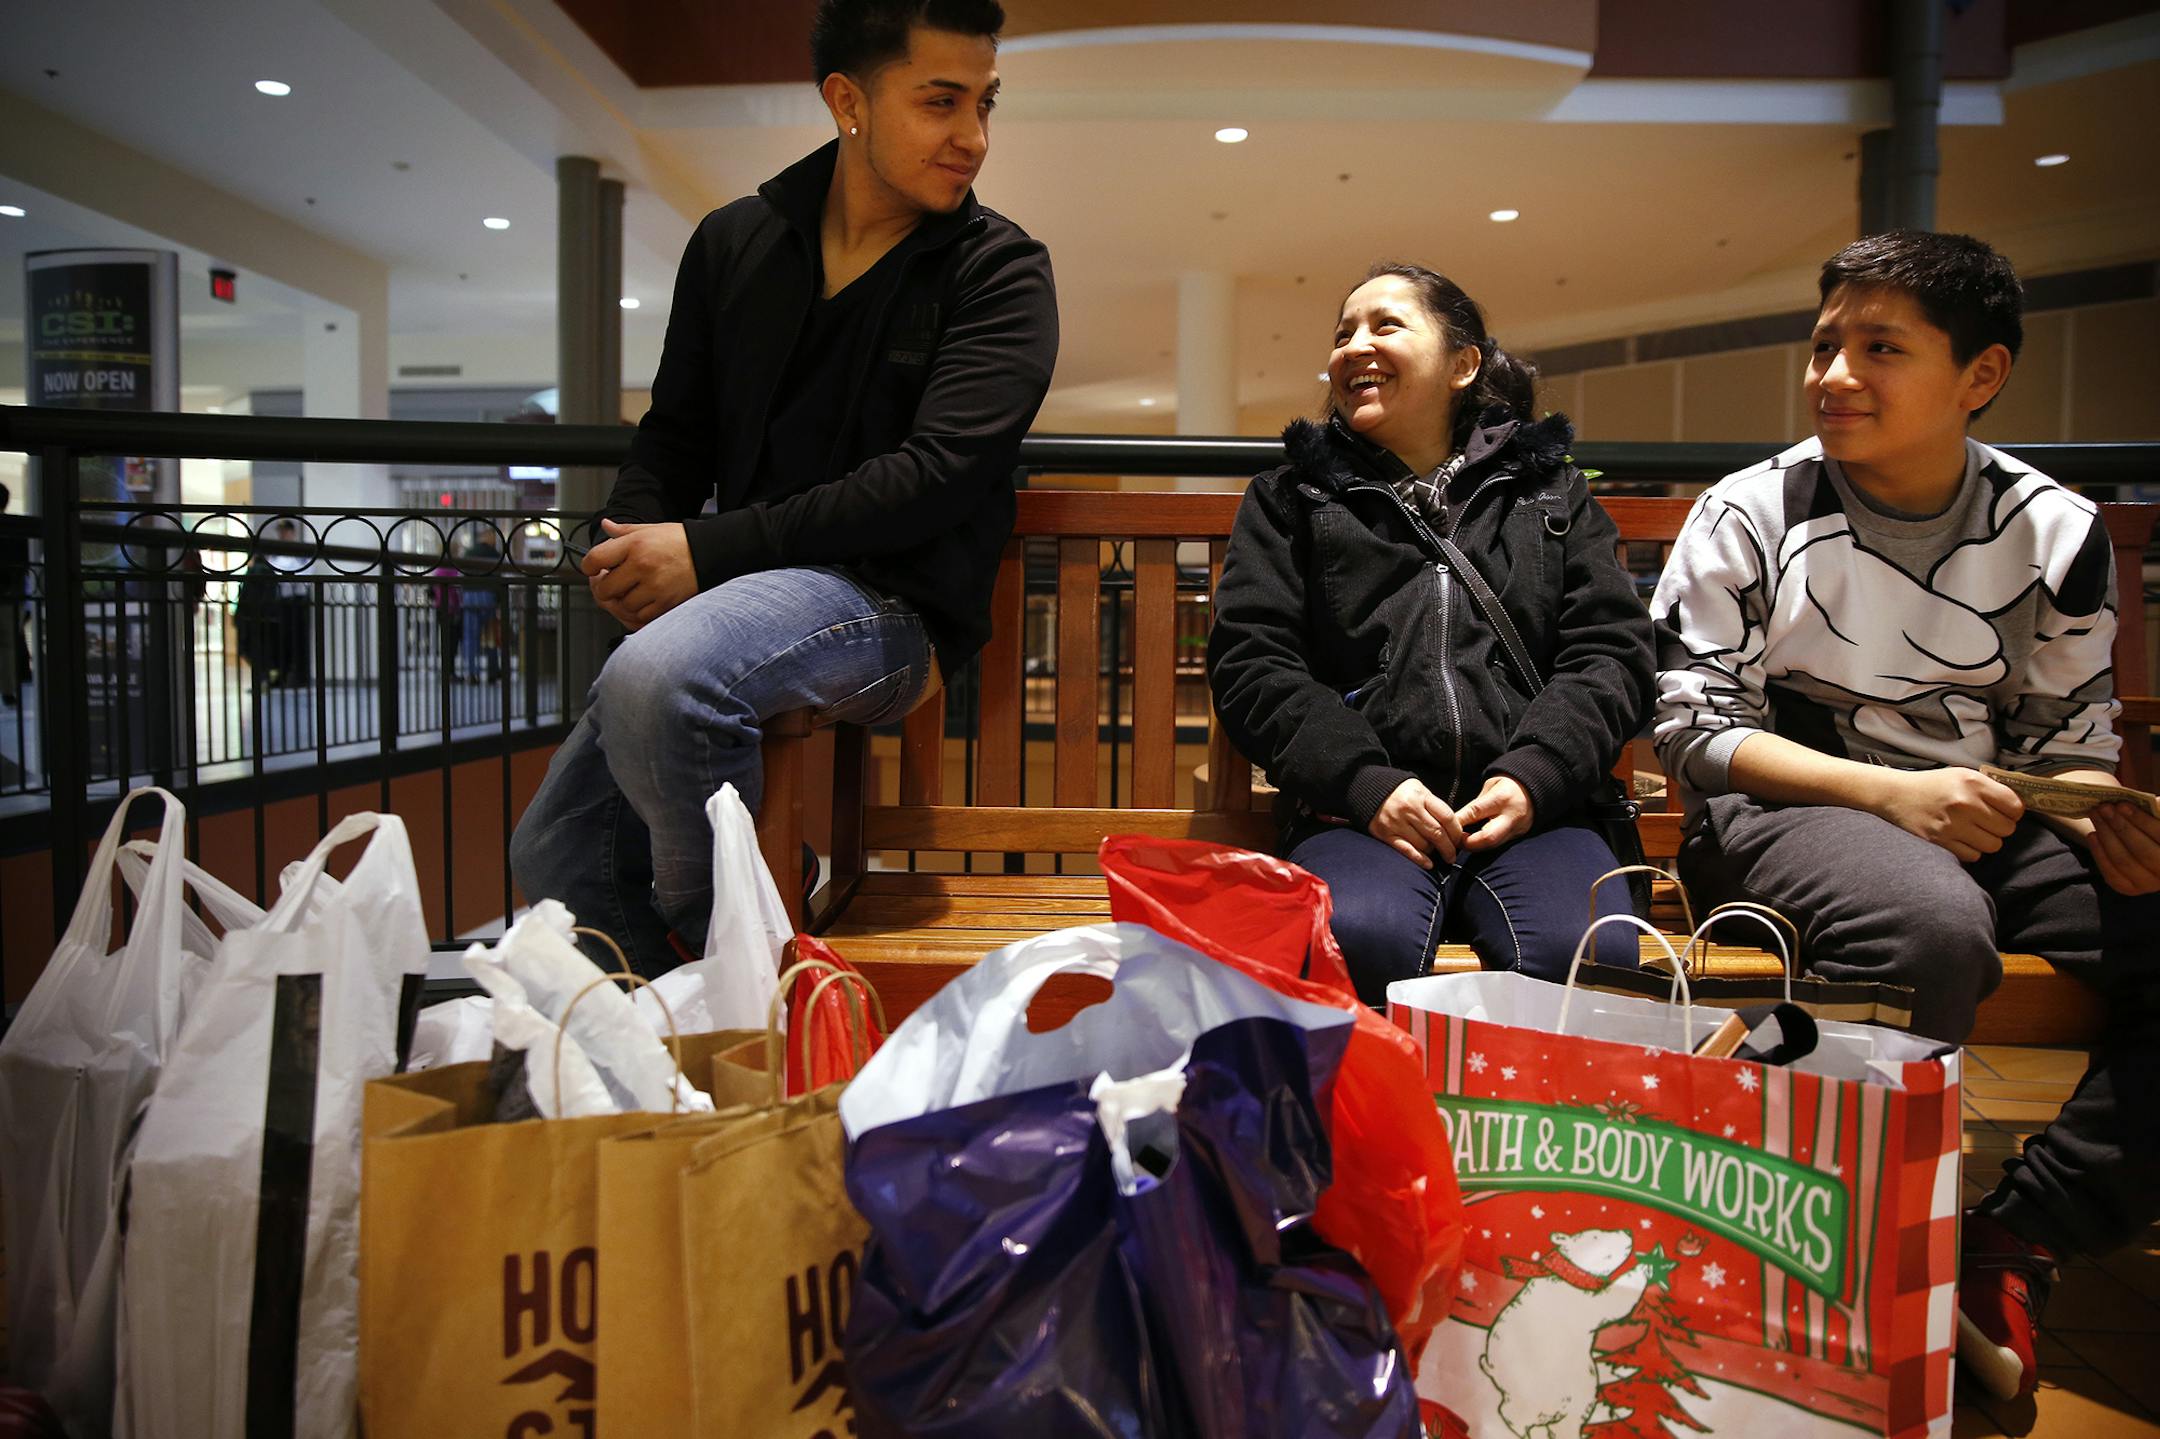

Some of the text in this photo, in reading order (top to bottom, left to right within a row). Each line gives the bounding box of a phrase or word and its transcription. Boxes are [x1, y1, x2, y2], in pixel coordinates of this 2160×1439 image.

[44, 370, 135, 392] NOW OPEN
[1533, 1117, 1564, 1172] &
[1570, 1122, 1674, 1190] BODY
[1681, 1141, 1833, 1274] WORKS
